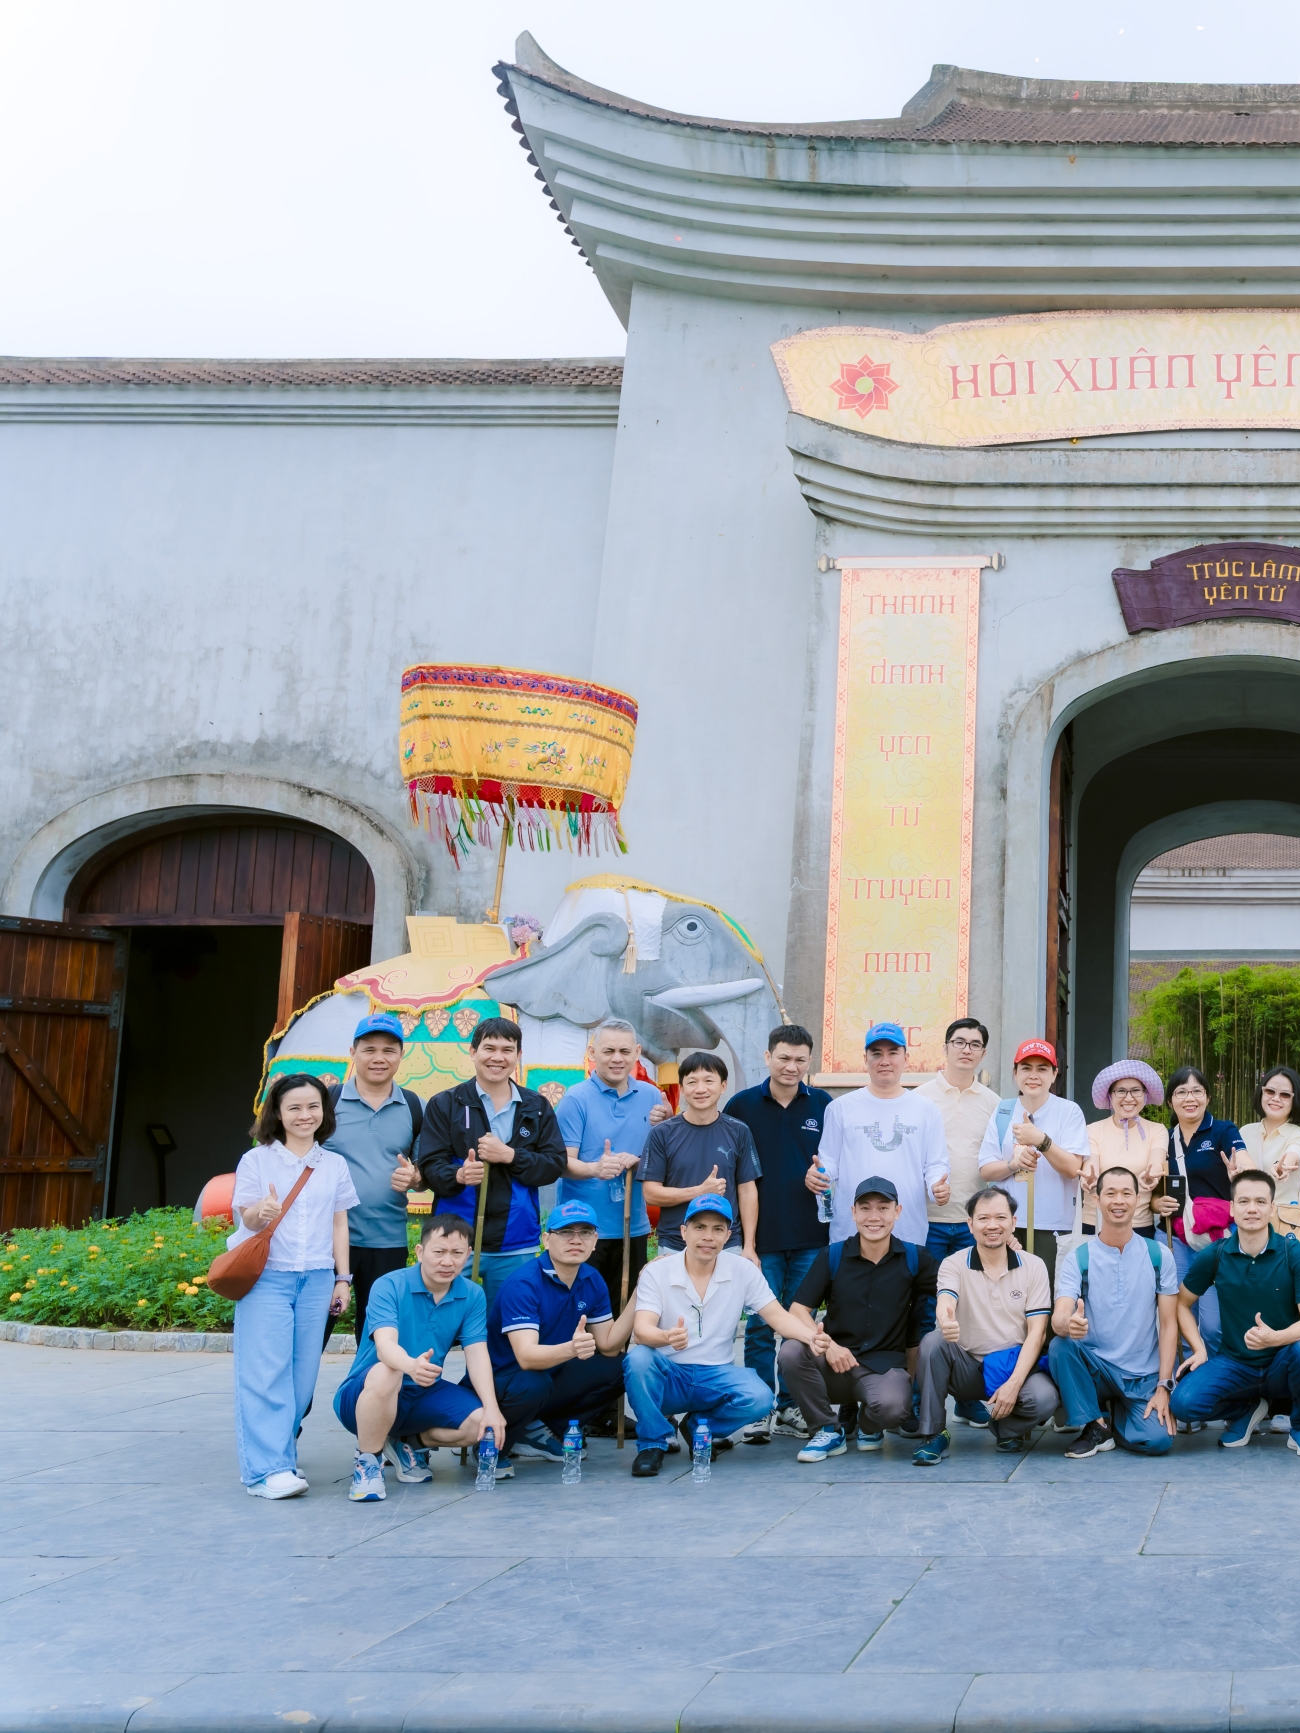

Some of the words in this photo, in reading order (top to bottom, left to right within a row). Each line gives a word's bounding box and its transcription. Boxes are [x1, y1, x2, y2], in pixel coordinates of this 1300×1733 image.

[948, 354, 1037, 404] HỘI
[1053, 347, 1197, 394] XUÂN
[1186, 558, 1244, 581] TRÚC
[862, 593, 956, 615] THANH
[1203, 583, 1248, 605] YÊN
[1254, 584, 1287, 602] TỬ
[879, 731, 932, 762] YÊN
[884, 802, 923, 827] TỬ
[847, 872, 952, 906] TRUYỀN
[863, 952, 932, 973] NAM
